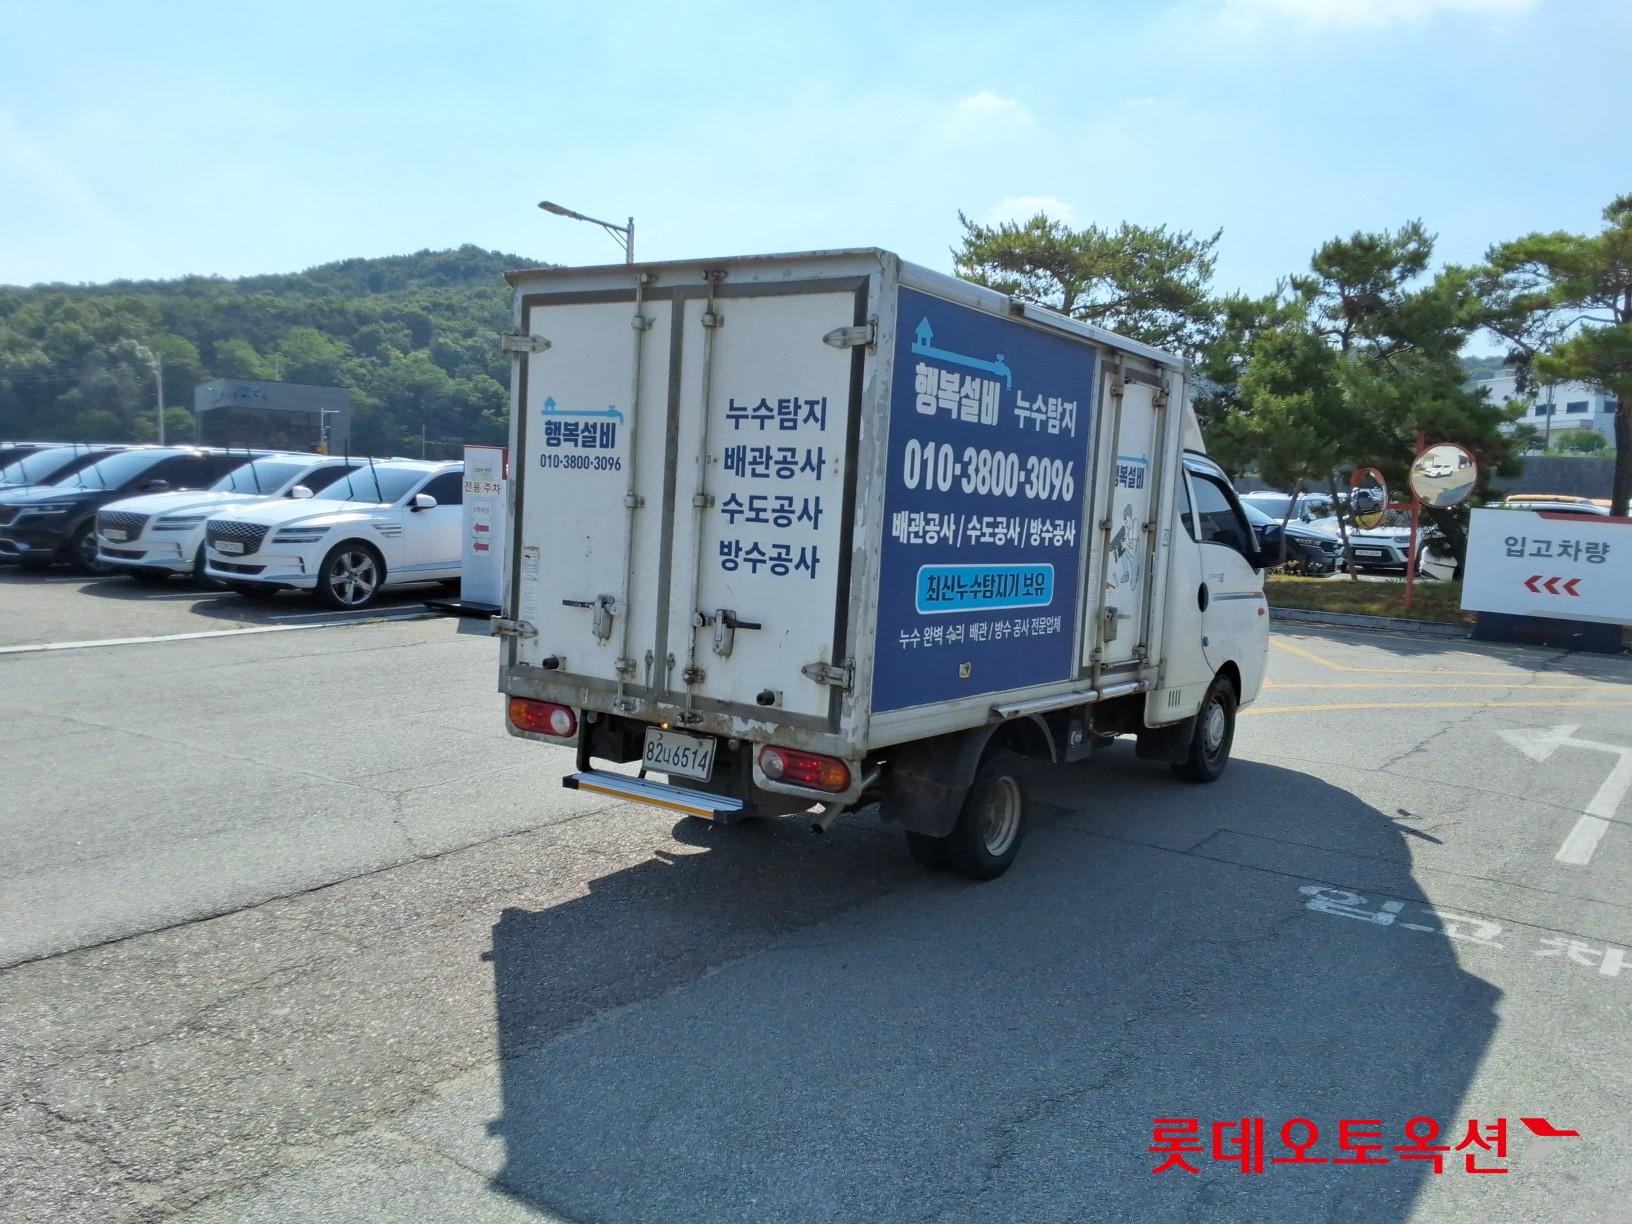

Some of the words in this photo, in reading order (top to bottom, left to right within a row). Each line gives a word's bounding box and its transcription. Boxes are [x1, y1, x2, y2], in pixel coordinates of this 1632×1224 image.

[726, 397, 828, 431] 누수탐지
[915, 362, 1000, 426] 행복설비
[1014, 390, 1077, 438] 누수탐지
[544, 420, 617, 449] 행복설비
[724, 445, 826, 480] 배관공사
[721, 493, 823, 530] 수도공사
[892, 510, 955, 545] 배관공사
[966, 514, 1020, 546] 수도공사
[1030, 517, 1076, 547] 방수공사
[719, 540, 820, 579] 방수공사
[1504, 536, 1611, 564] 입고차량
[926, 572, 1019, 602] 최신누수탐지기
[1022, 572, 1046, 597] 보유
[899, 628, 921, 650] 누수
[923, 626, 944, 648] 완벽
[946, 623, 965, 645] 수리
[969, 621, 988, 642] 배관
[994, 620, 1012, 640] 방수
[1013, 616, 1030, 638] 공사
